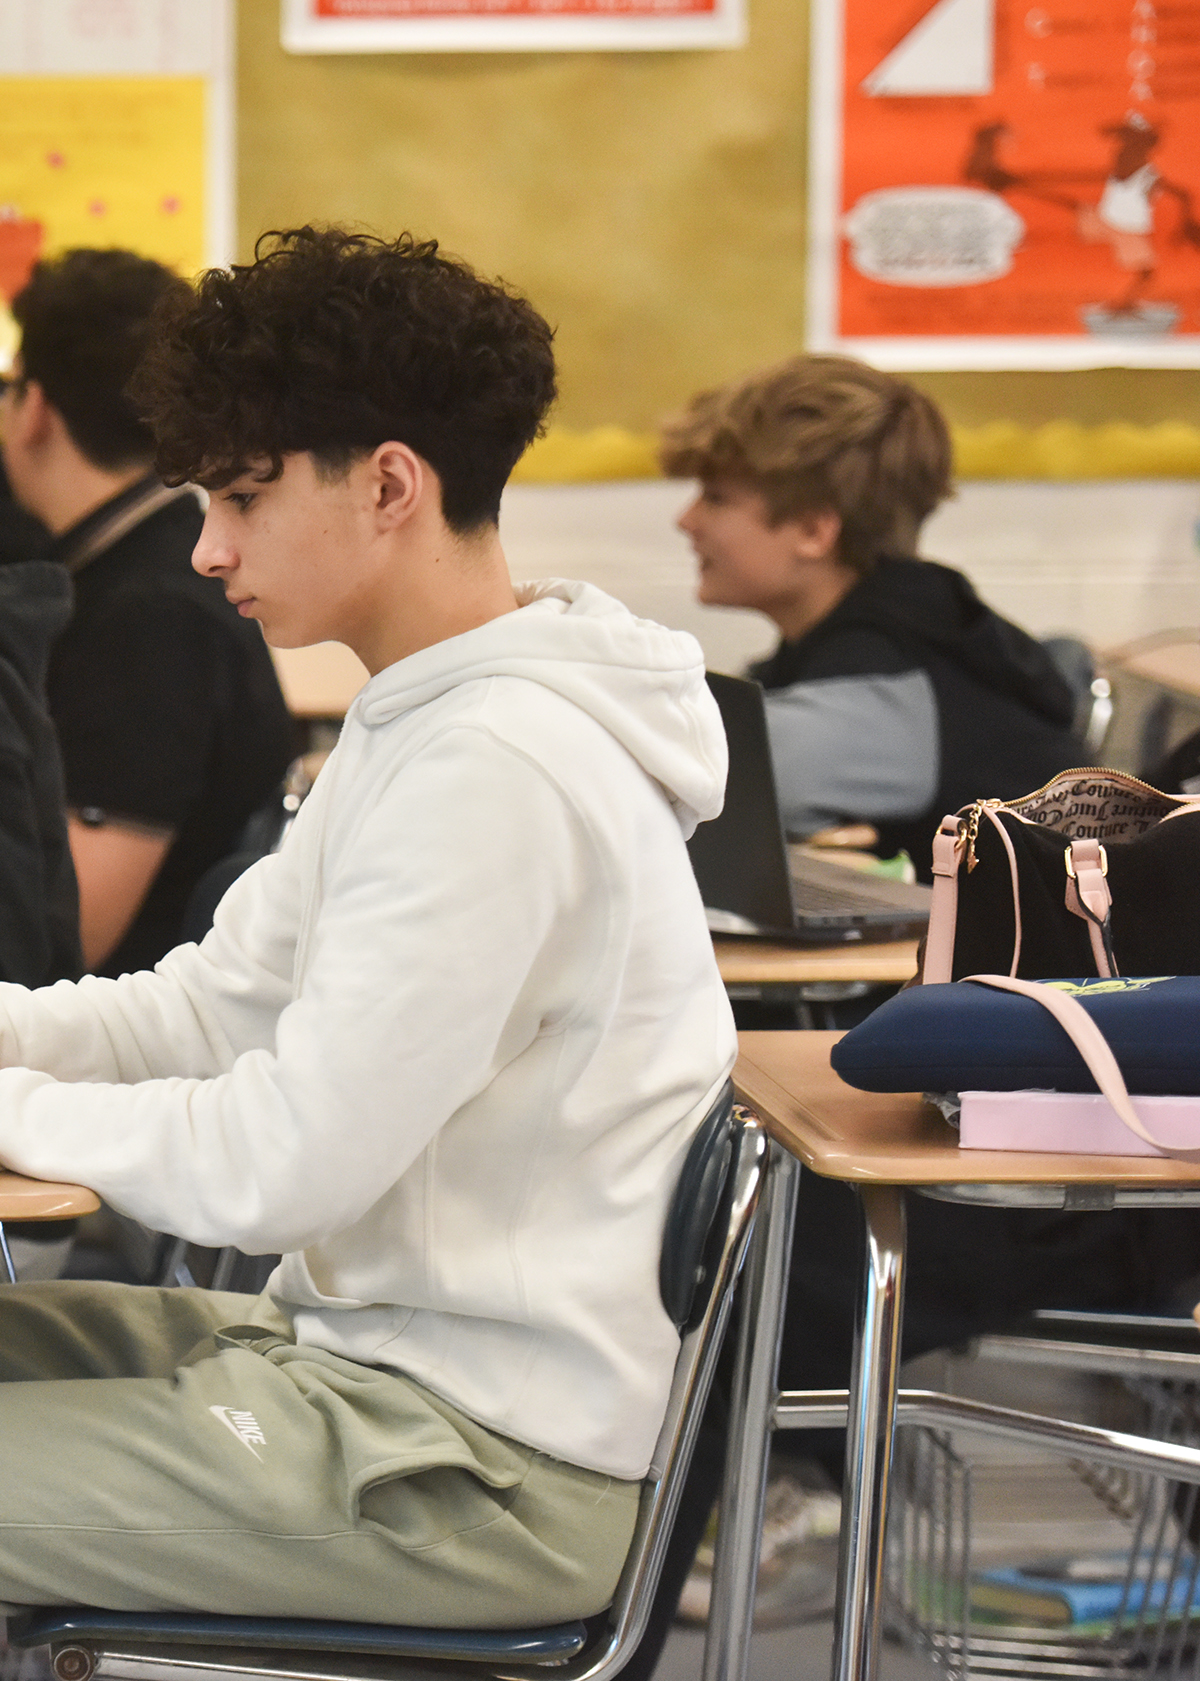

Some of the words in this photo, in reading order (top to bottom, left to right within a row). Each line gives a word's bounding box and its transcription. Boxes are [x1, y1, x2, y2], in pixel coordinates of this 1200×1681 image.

[1065, 800, 1110, 821] Juicy
[1111, 804, 1169, 818] outure
[229, 1410, 267, 1445] NIKE
